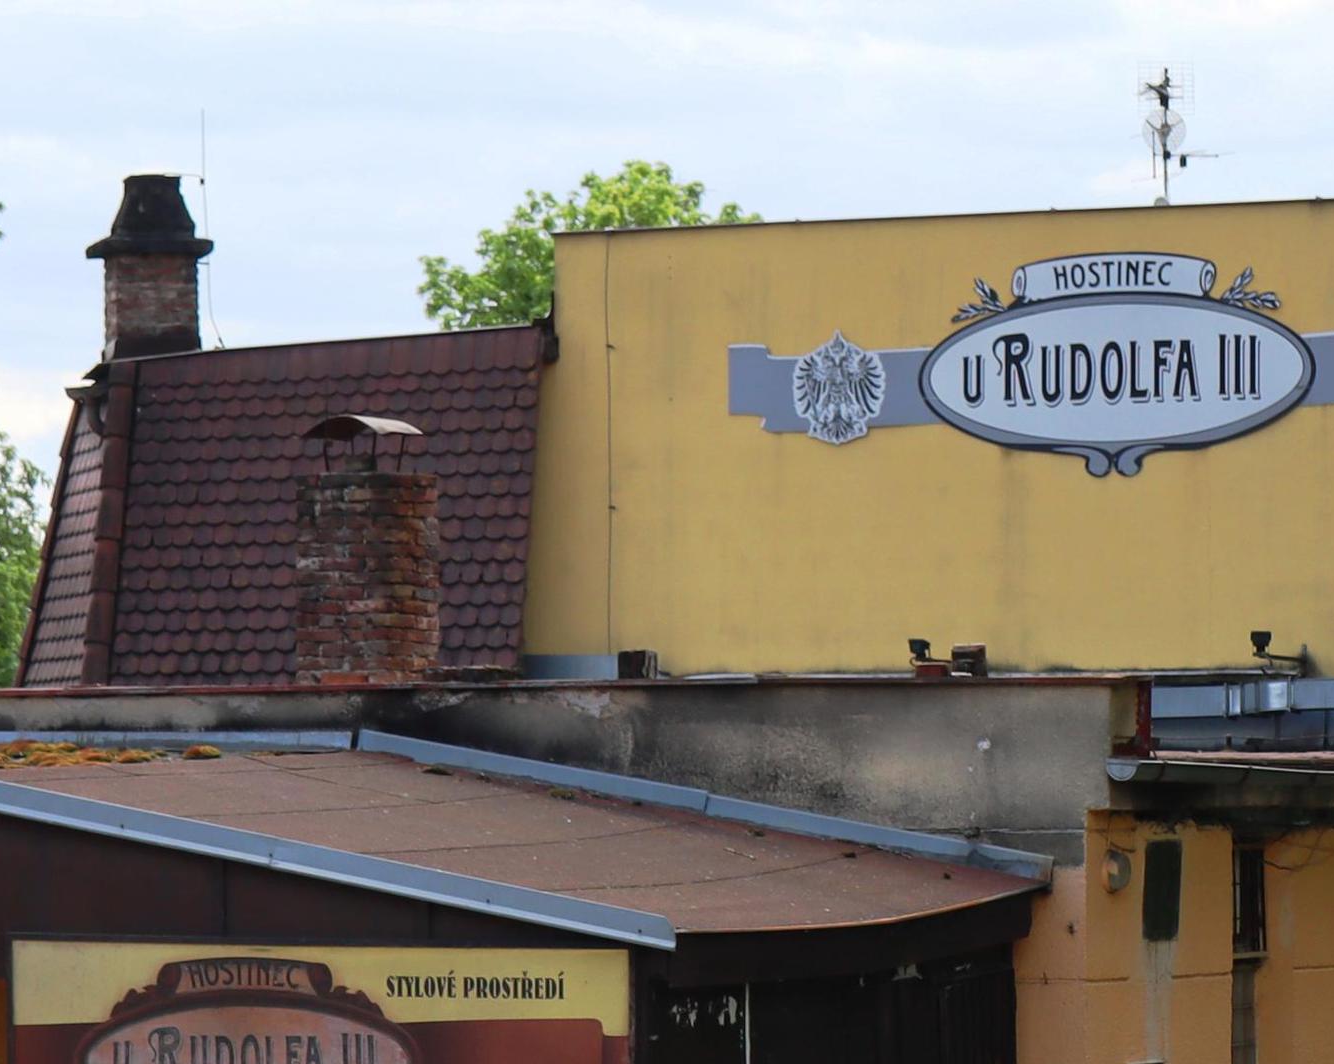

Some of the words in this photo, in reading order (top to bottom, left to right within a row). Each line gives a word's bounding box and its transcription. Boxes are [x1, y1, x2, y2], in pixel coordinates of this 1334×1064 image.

[1053, 260, 1173, 291] HOSTINEC
[1218, 334, 1261, 401] III
[189, 962, 302, 990] HOSTINEC
[385, 968, 458, 999] STYLOVÉ
[463, 970, 565, 1001] PROSTŘEDÍ
